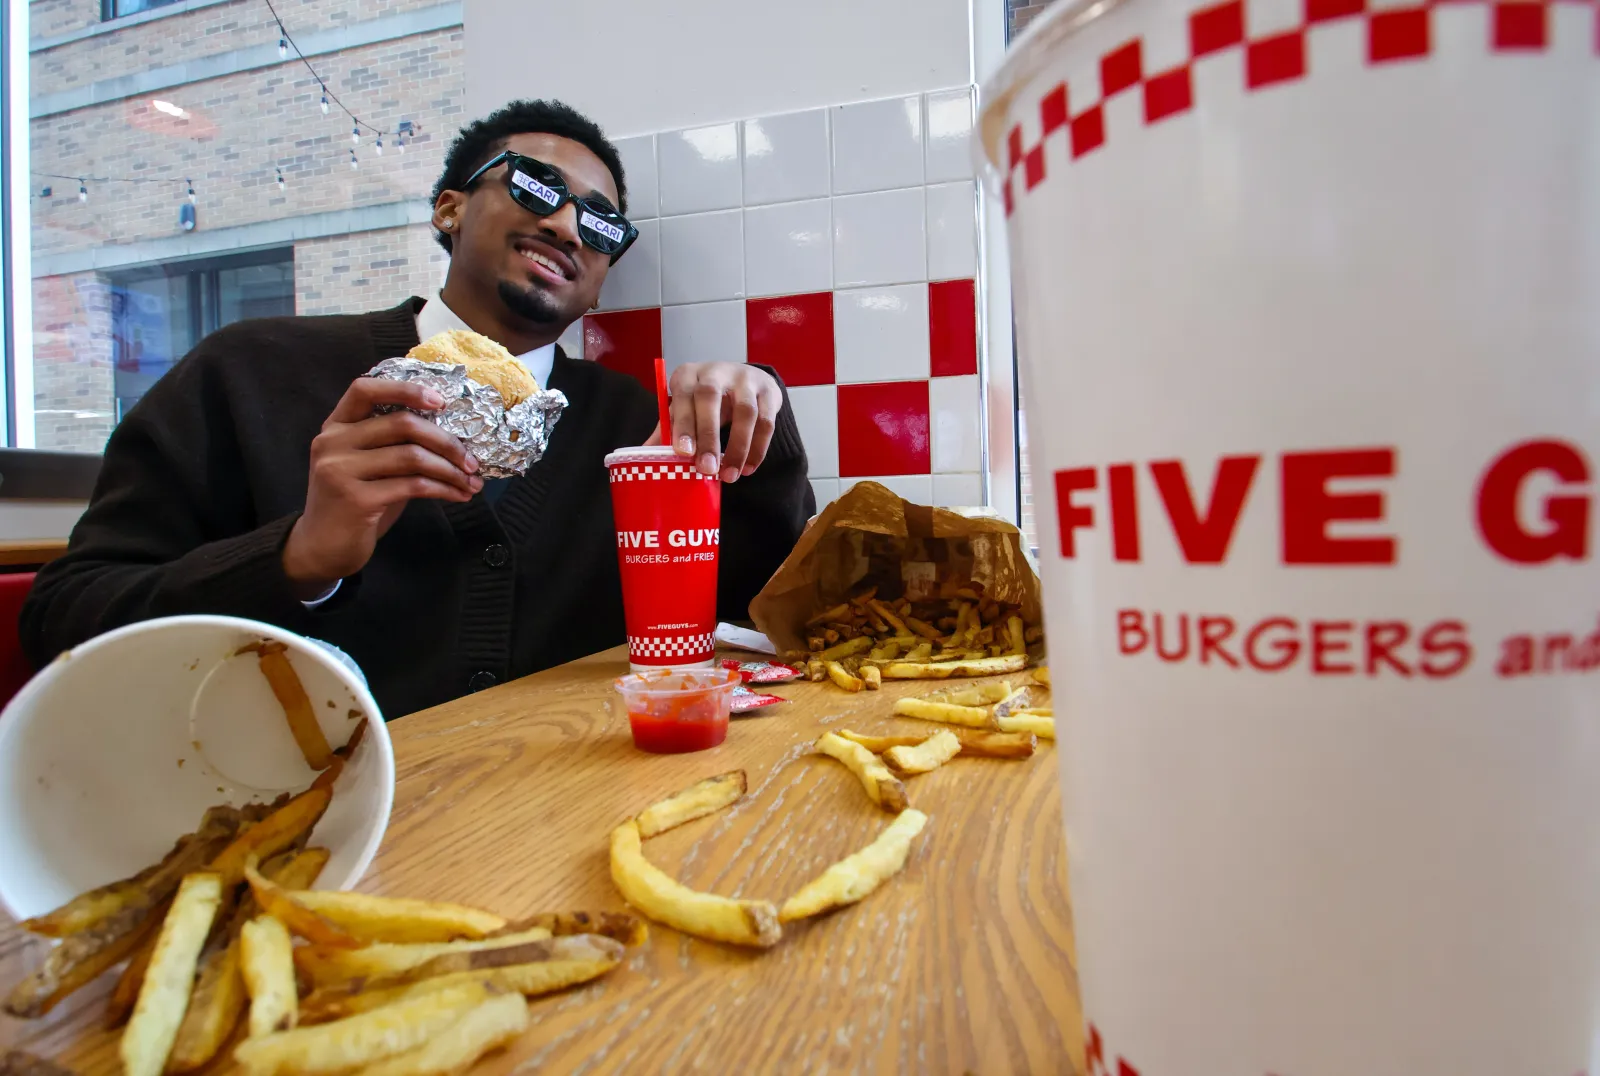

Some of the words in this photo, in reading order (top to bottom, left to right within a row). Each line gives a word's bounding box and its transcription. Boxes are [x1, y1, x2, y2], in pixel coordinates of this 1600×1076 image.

[527, 180, 557, 204] CARI
[594, 220, 621, 240] CARI
[1053, 446, 1398, 567] FIVE
[617, 530, 660, 548] FIVE
[668, 528, 720, 548] GUYS
[625, 554, 670, 564] BURGERS
[672, 553, 692, 563] and
[693, 551, 715, 562] FRIES
[647, 622, 699, 630] www.FIVEGUYS.com
[1116, 608, 1473, 680] BURGERS
